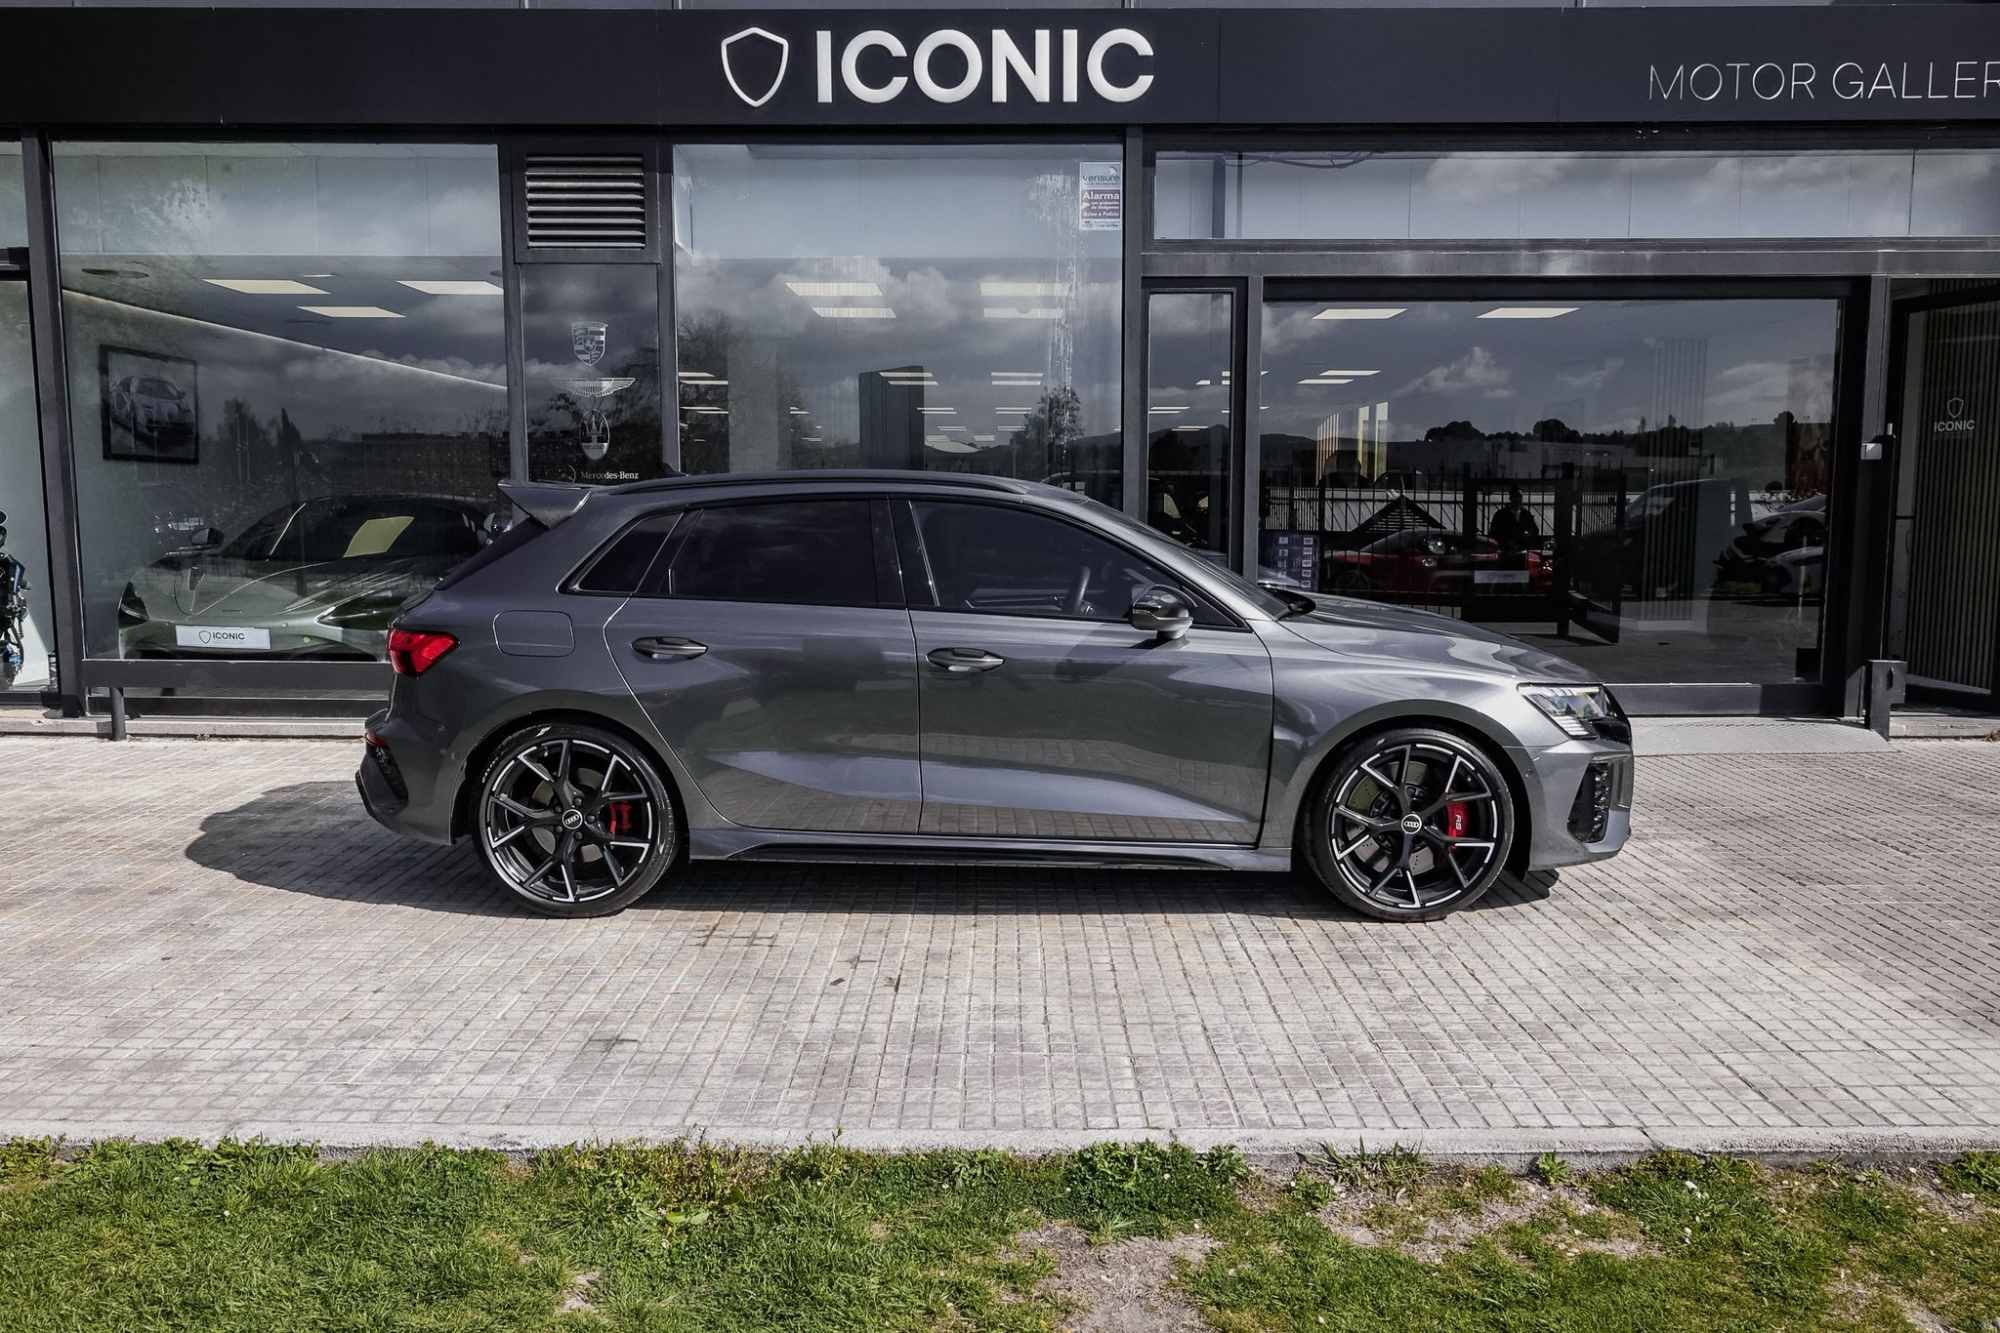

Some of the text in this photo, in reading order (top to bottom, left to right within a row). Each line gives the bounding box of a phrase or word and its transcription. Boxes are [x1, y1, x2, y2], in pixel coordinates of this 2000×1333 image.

[816, 28, 1154, 103] ICONIC
[1649, 63, 1815, 101] MOTOR
[1082, 174, 1120, 182] verisure
[1082, 191, 1120, 200] Alarma
[1934, 420, 1975, 433] ICONIC
[581, 471, 639, 479] Mercedes-Benz
[213, 632, 245, 640] ICONIC
[1455, 814, 1462, 831] RS
